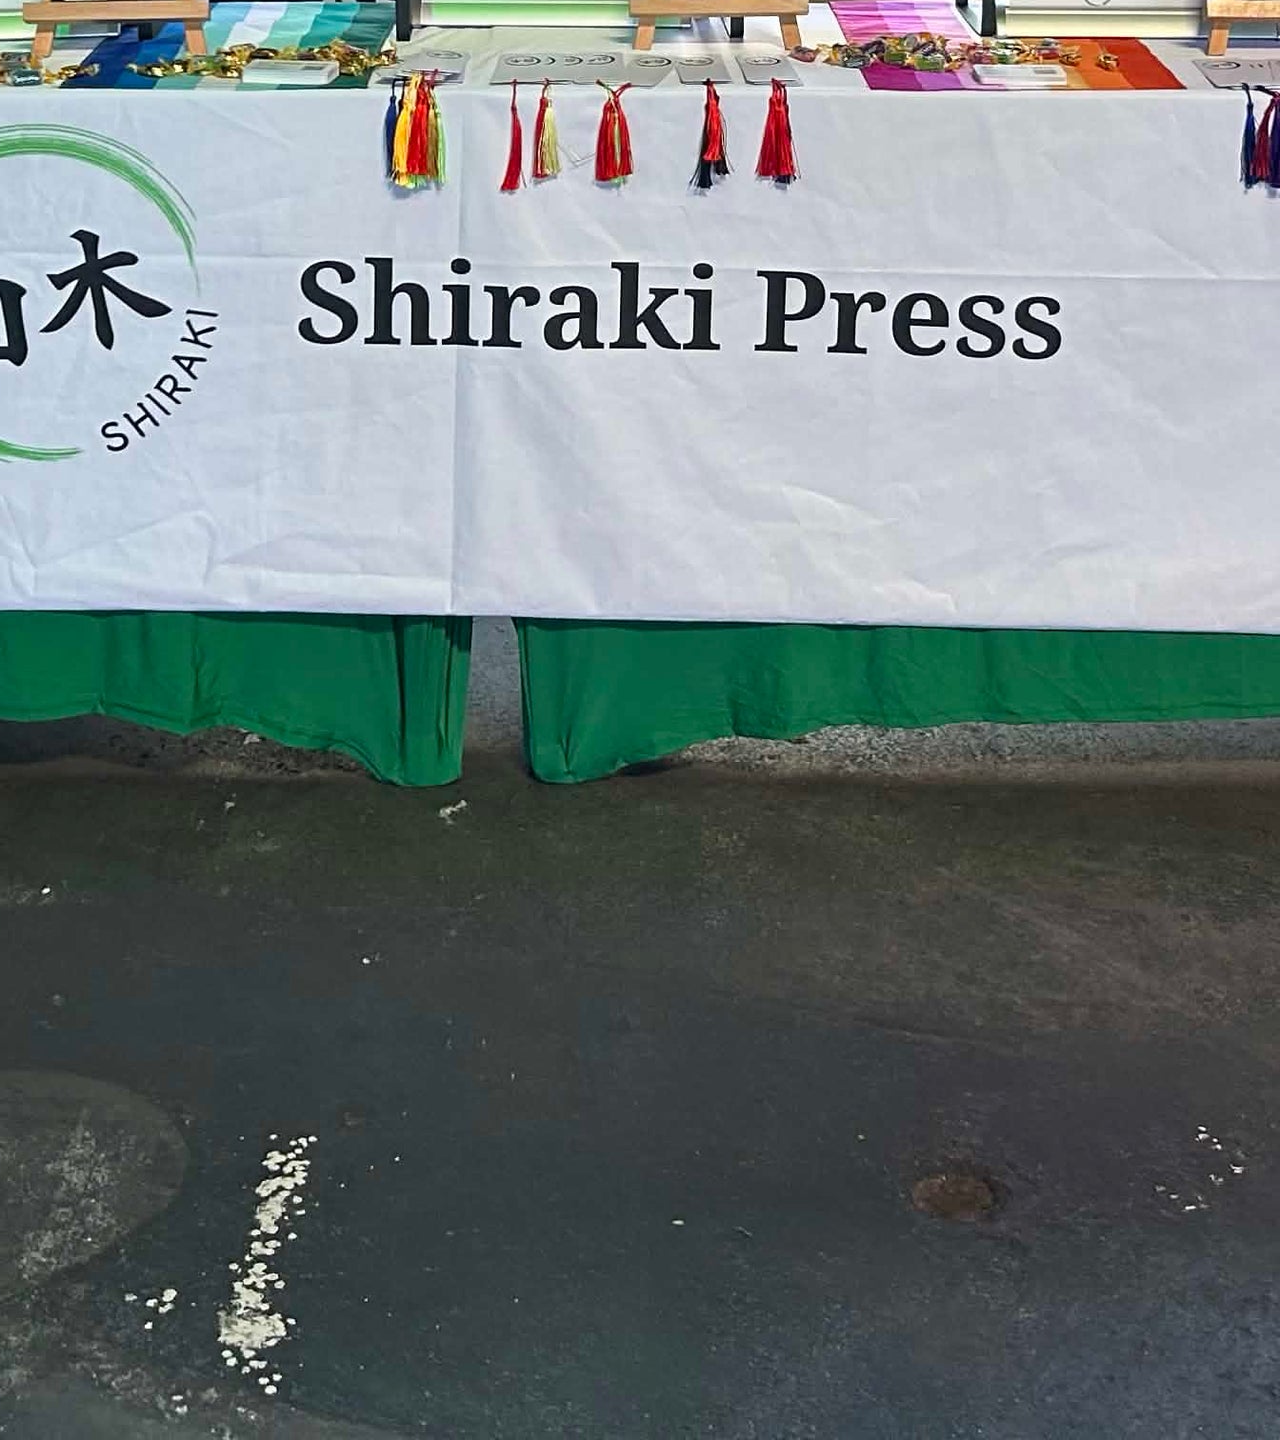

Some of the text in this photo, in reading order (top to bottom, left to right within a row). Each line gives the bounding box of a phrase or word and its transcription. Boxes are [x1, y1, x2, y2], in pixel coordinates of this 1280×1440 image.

[297, 257, 1065, 362] Shiraki Press
[100, 307, 220, 453] SHIRAKI
